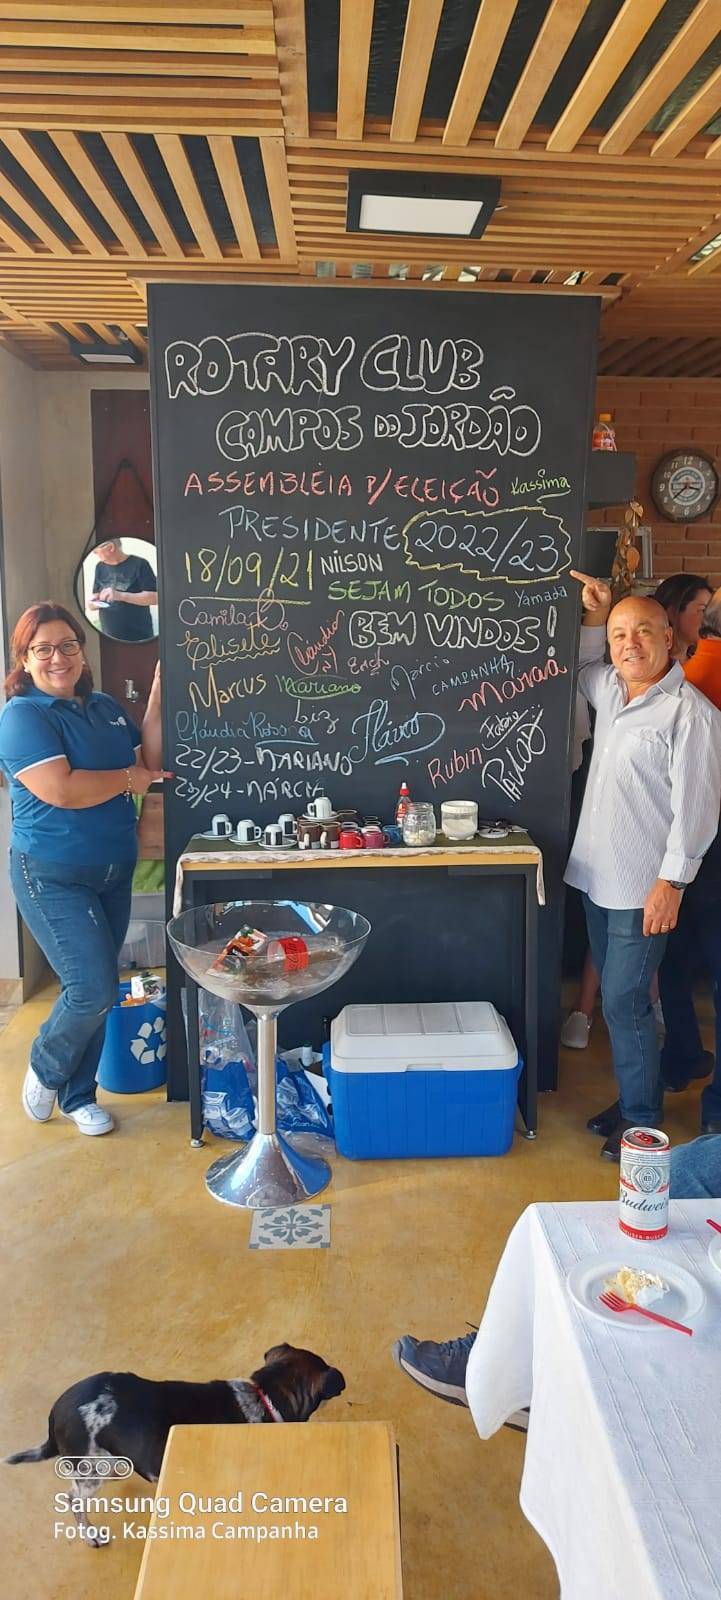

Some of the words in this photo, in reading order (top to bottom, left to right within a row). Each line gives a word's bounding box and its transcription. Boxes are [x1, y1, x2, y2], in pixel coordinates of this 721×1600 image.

[165, 332, 355, 398] ROTARY
[359, 334, 484, 394] CLUB
[216, 404, 364, 461] CAMPOS
[374, 411, 398, 438] DO
[398, 386, 541, 456] JORDÃO
[218, 505, 401, 551] PRESIDENTE
[414, 516, 559, 573] 2022/23
[185, 545, 313, 597] 18/09/21
[327, 580, 412, 602] SEJAM
[418, 579, 505, 612] TODOS
[349, 610, 417, 648] BEM
[188, 665, 267, 718] Marcus
[621, 1188, 669, 1212] Budwei
